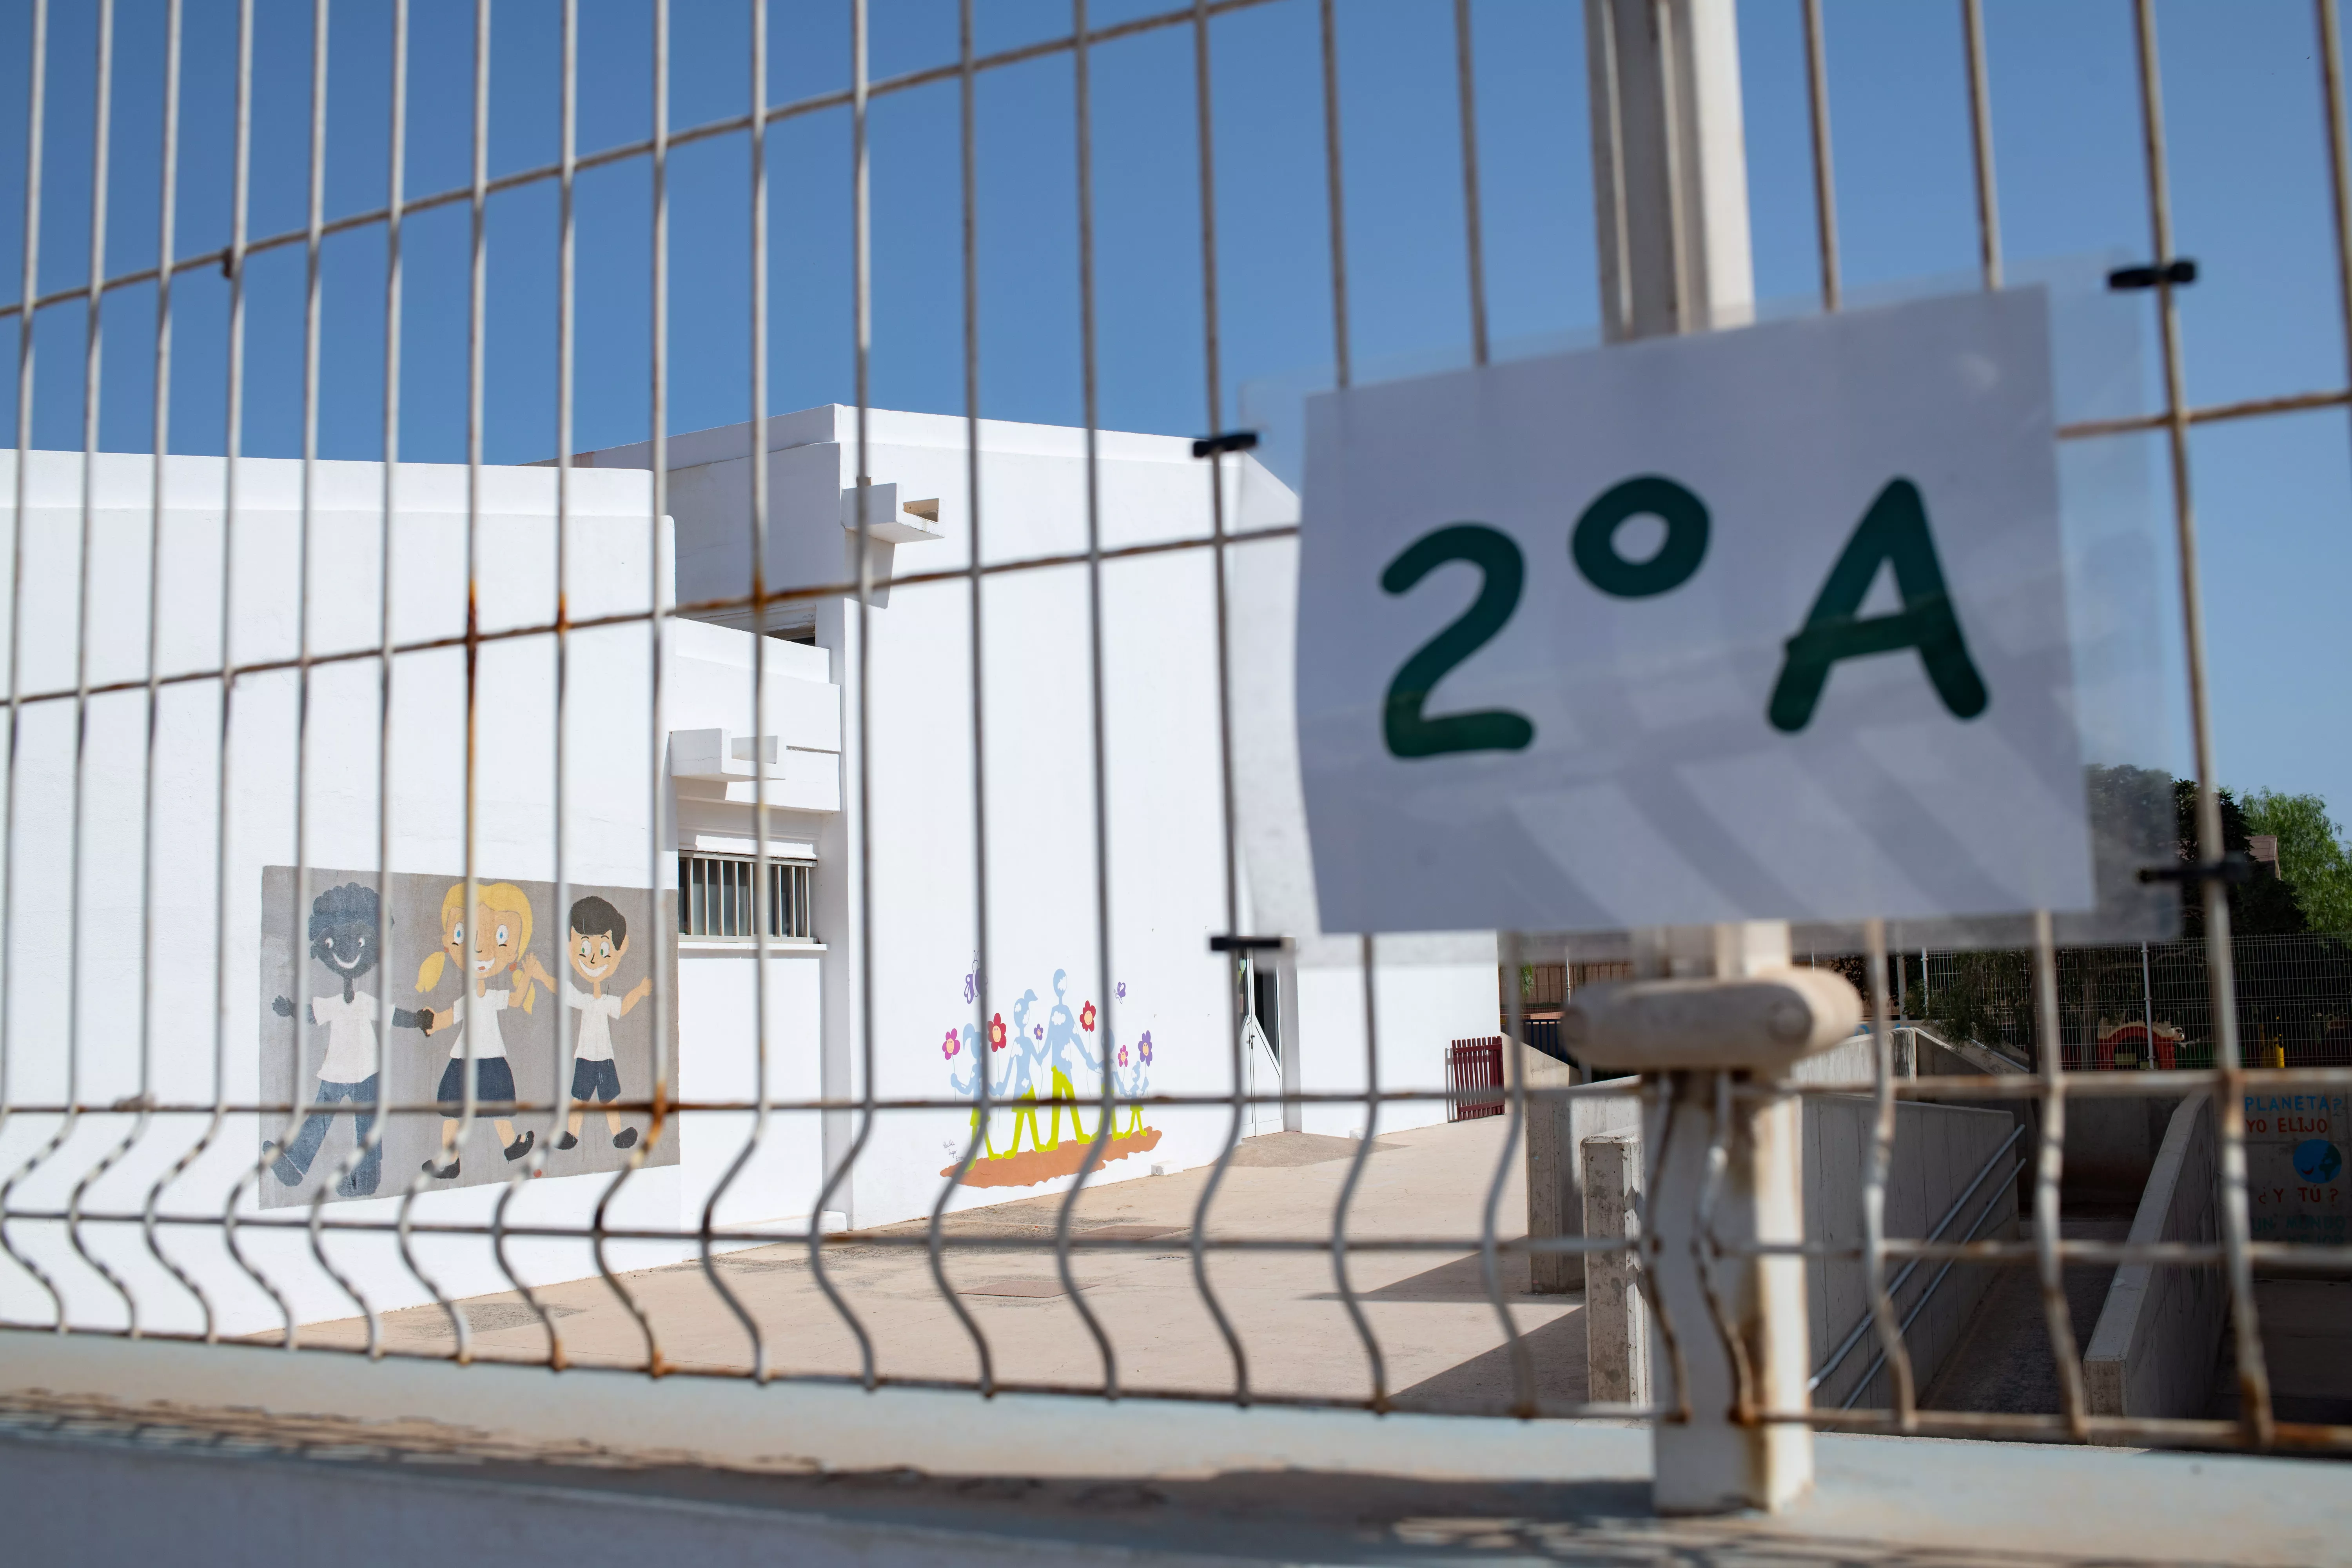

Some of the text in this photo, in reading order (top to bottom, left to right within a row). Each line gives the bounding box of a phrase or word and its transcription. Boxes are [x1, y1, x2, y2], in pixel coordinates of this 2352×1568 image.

[1766, 475, 1992, 735] A
[2245, 1096, 2342, 1113] PLANETA?
[2246, 1117, 2327, 1133] YO ELIJO
[942, 1139, 955, 1149] Paula
[948, 1149, 957, 1158] Iago
[2251, 1215, 2346, 1232] UN MUNDO
